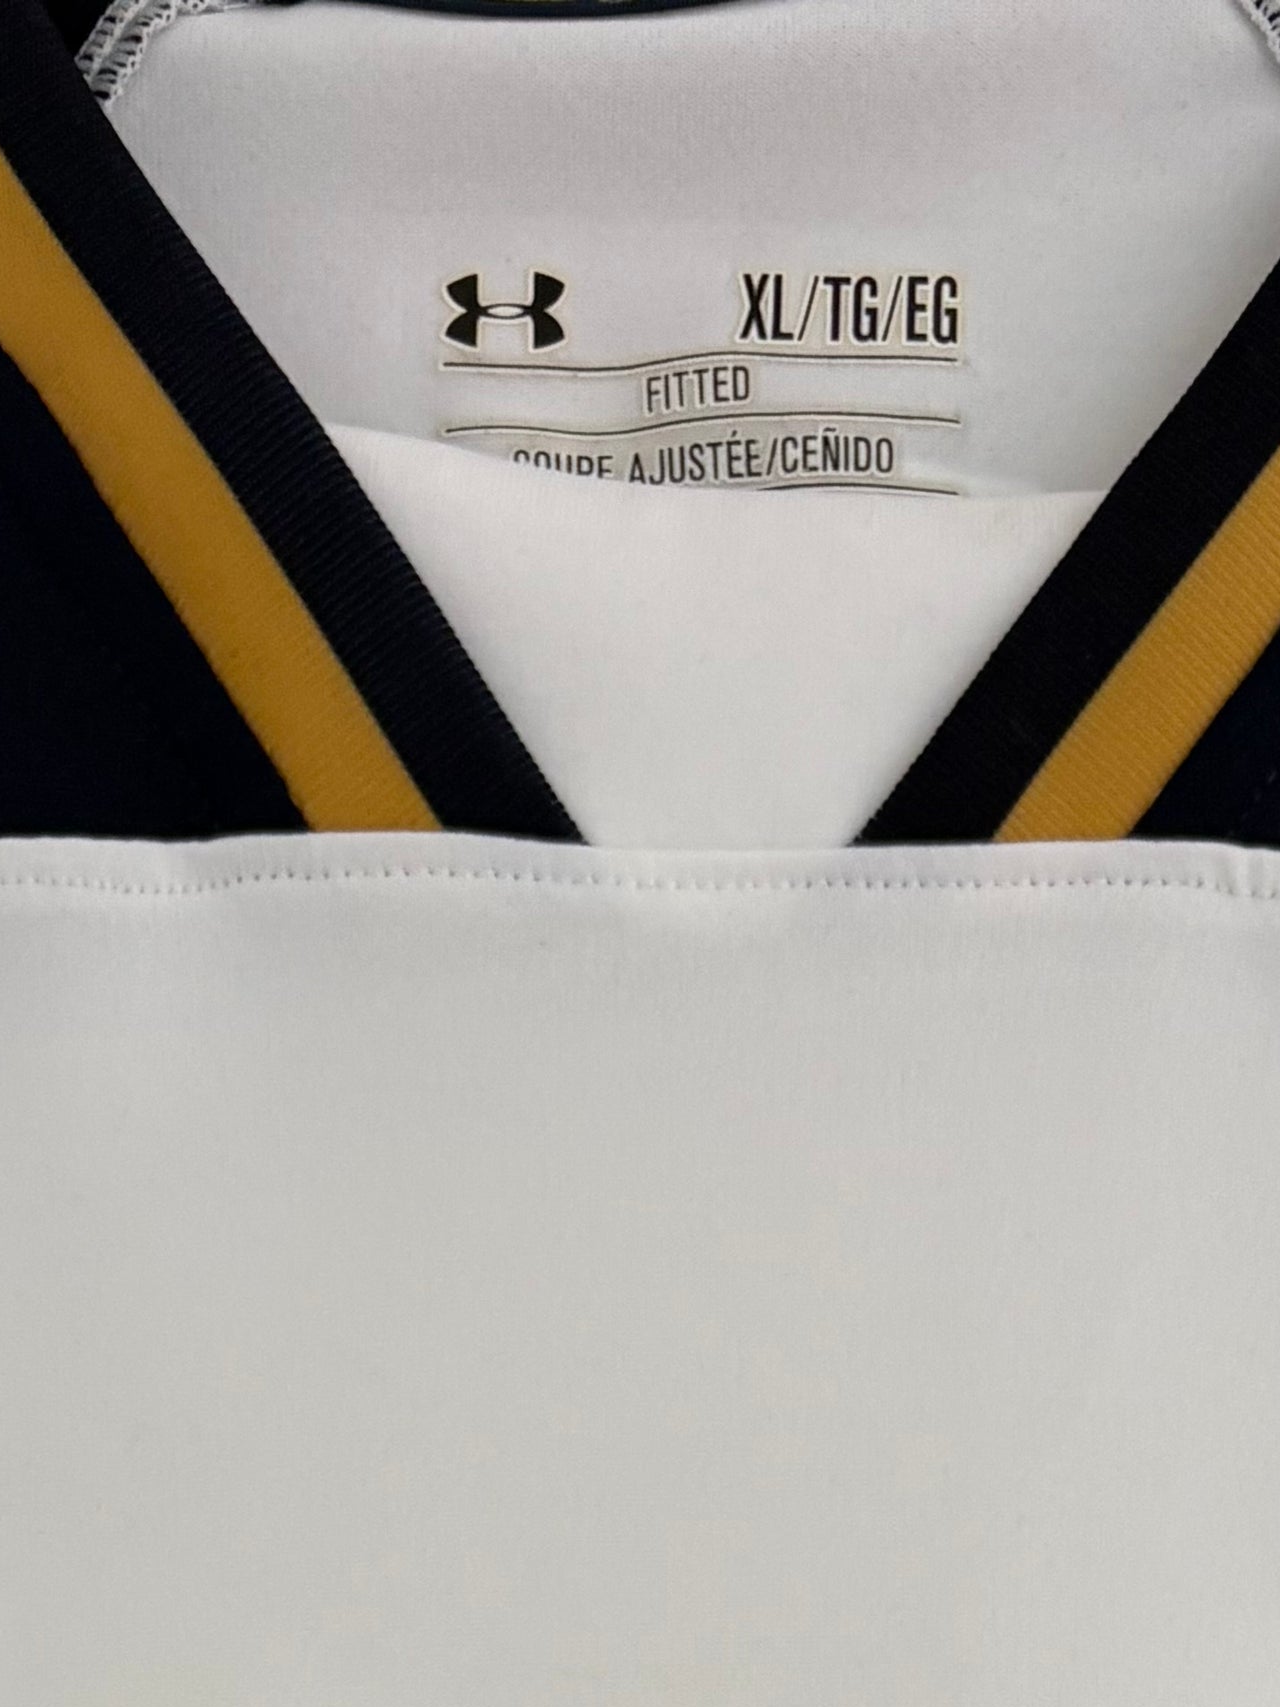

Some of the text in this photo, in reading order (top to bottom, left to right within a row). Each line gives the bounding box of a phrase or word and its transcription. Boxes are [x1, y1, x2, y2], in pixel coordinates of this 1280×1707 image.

[739, 271, 959, 345] XL/TG/EG
[645, 365, 751, 413] FITTED
[629, 428, 894, 485] AJUSTÉE/CEÑIDO
